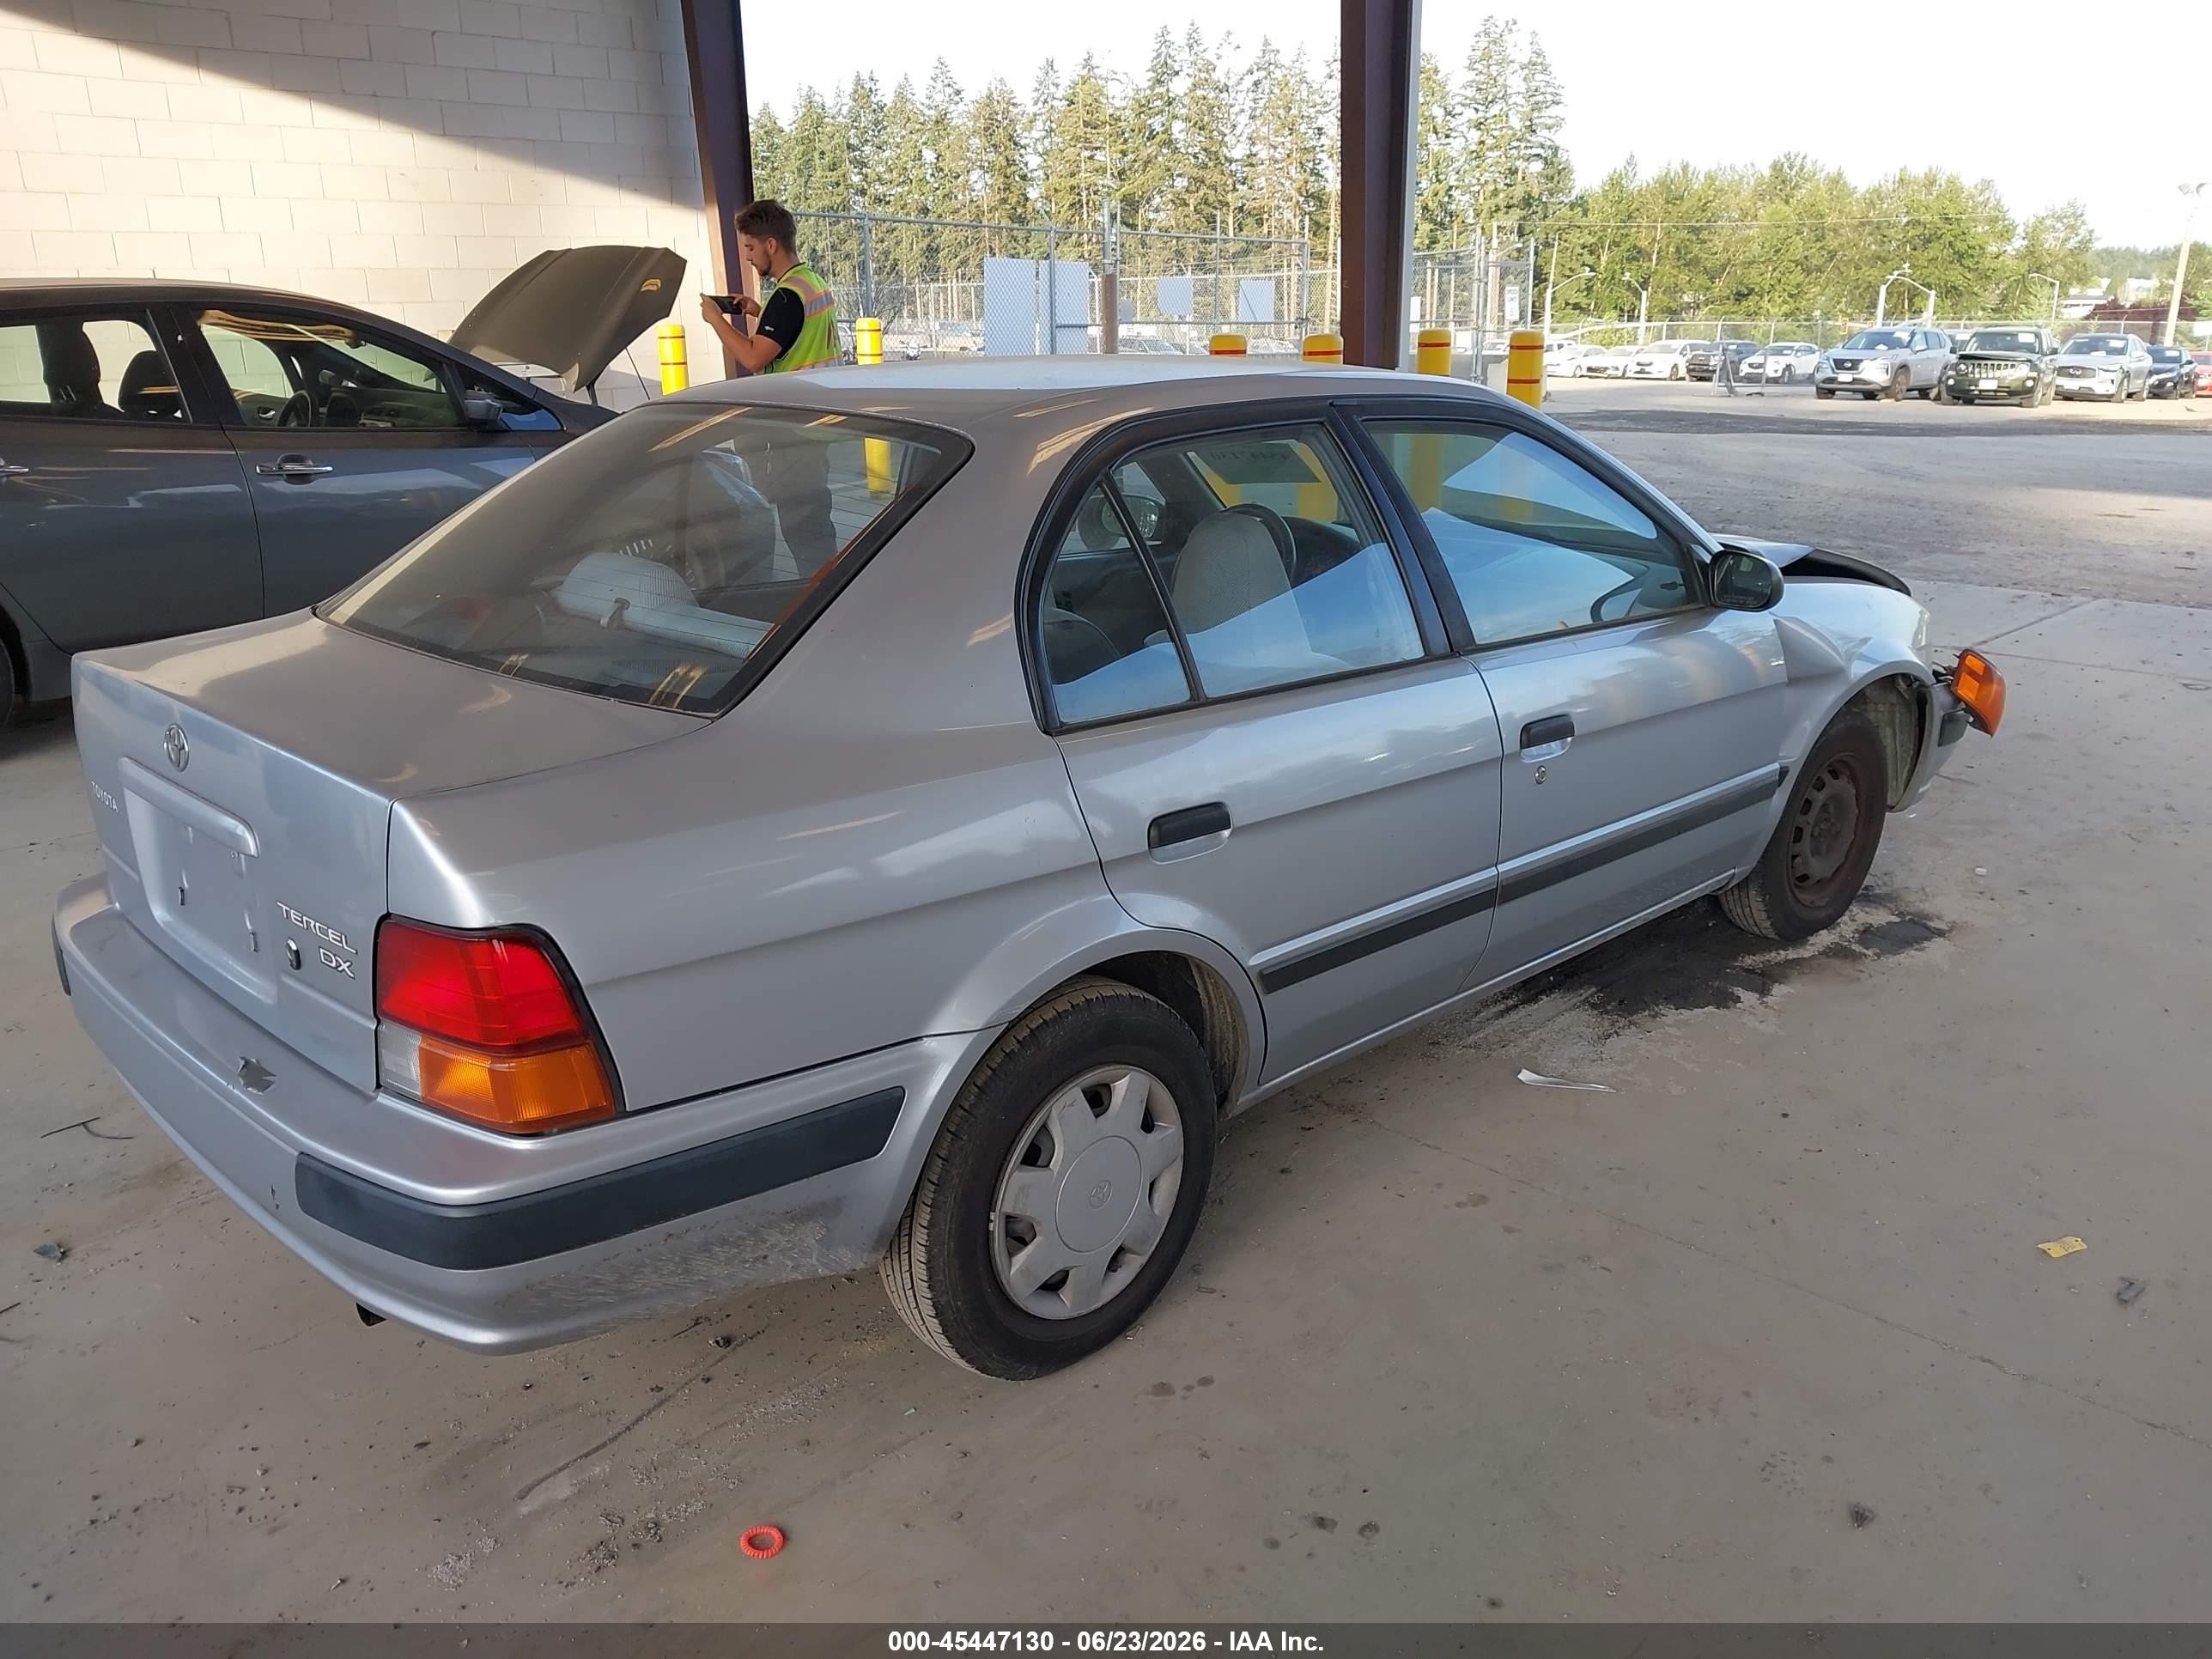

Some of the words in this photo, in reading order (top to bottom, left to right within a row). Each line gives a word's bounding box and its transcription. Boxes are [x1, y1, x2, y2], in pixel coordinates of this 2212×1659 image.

[91, 781, 118, 813] TOYOTA
[276, 901, 357, 955] TERCEL
[319, 946, 356, 979] DX
